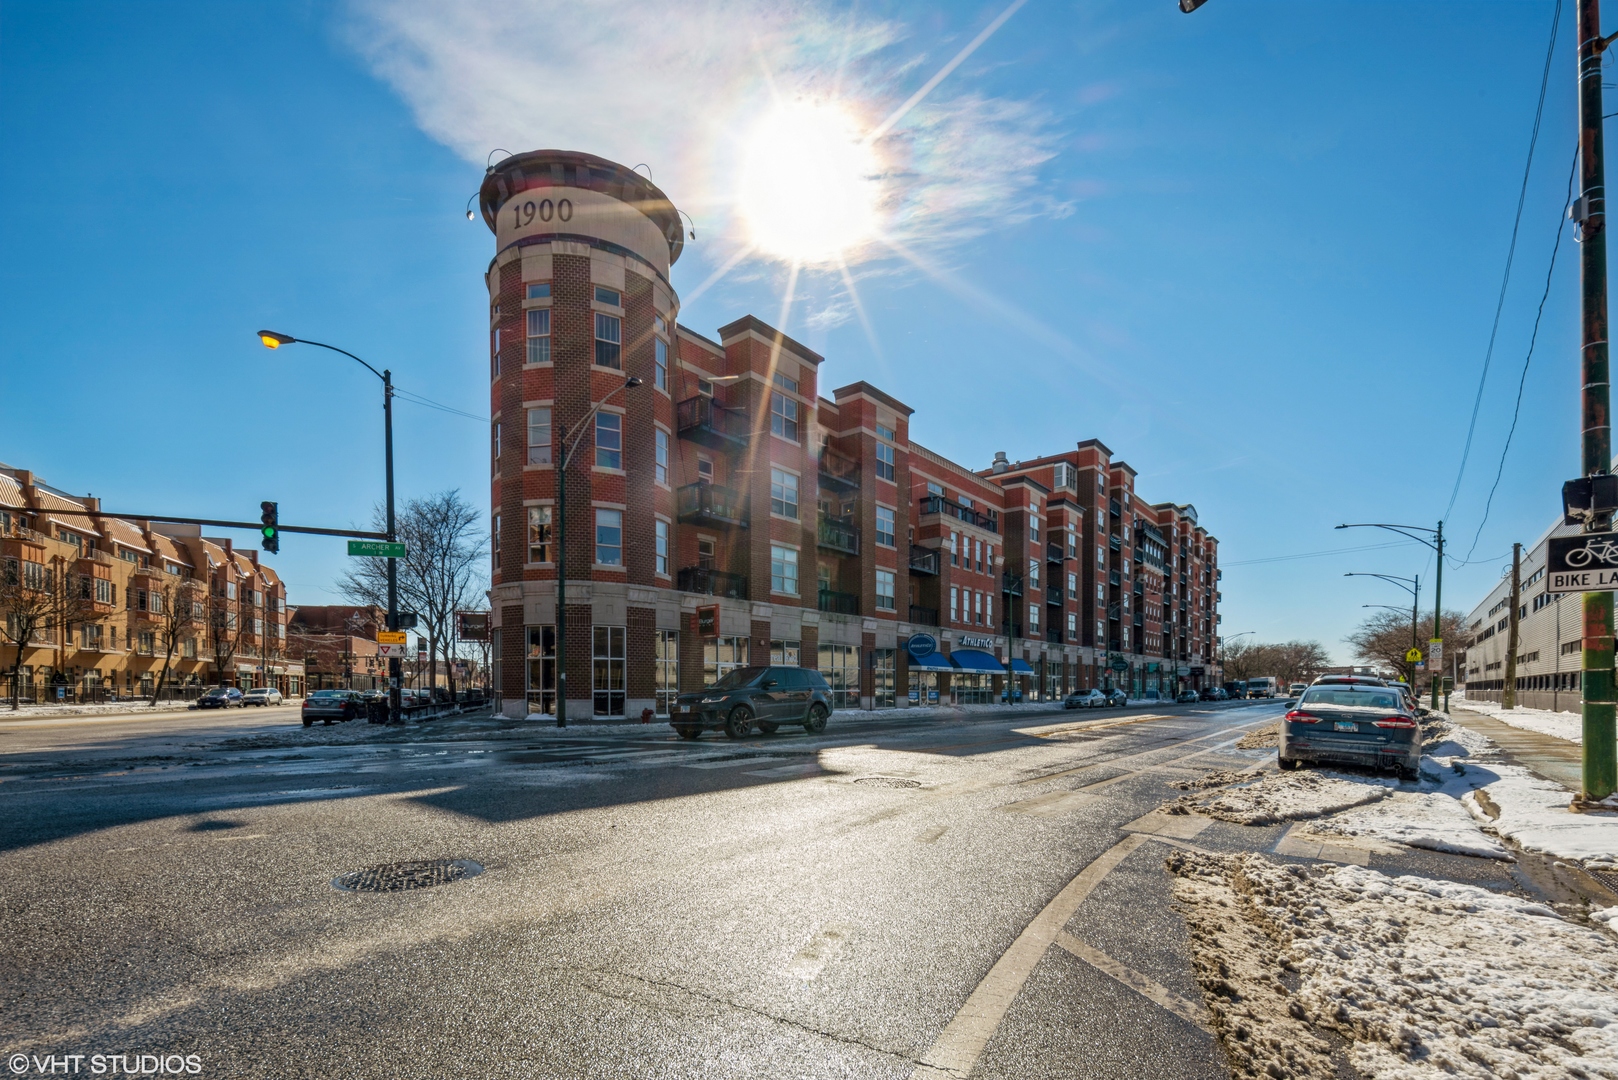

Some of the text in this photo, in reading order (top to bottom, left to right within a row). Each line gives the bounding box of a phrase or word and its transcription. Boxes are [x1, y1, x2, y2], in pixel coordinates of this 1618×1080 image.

[514, 199, 573, 229] 1900
[361, 543, 390, 551] ARCHER
[1554, 573, 1591, 588] BIKE
